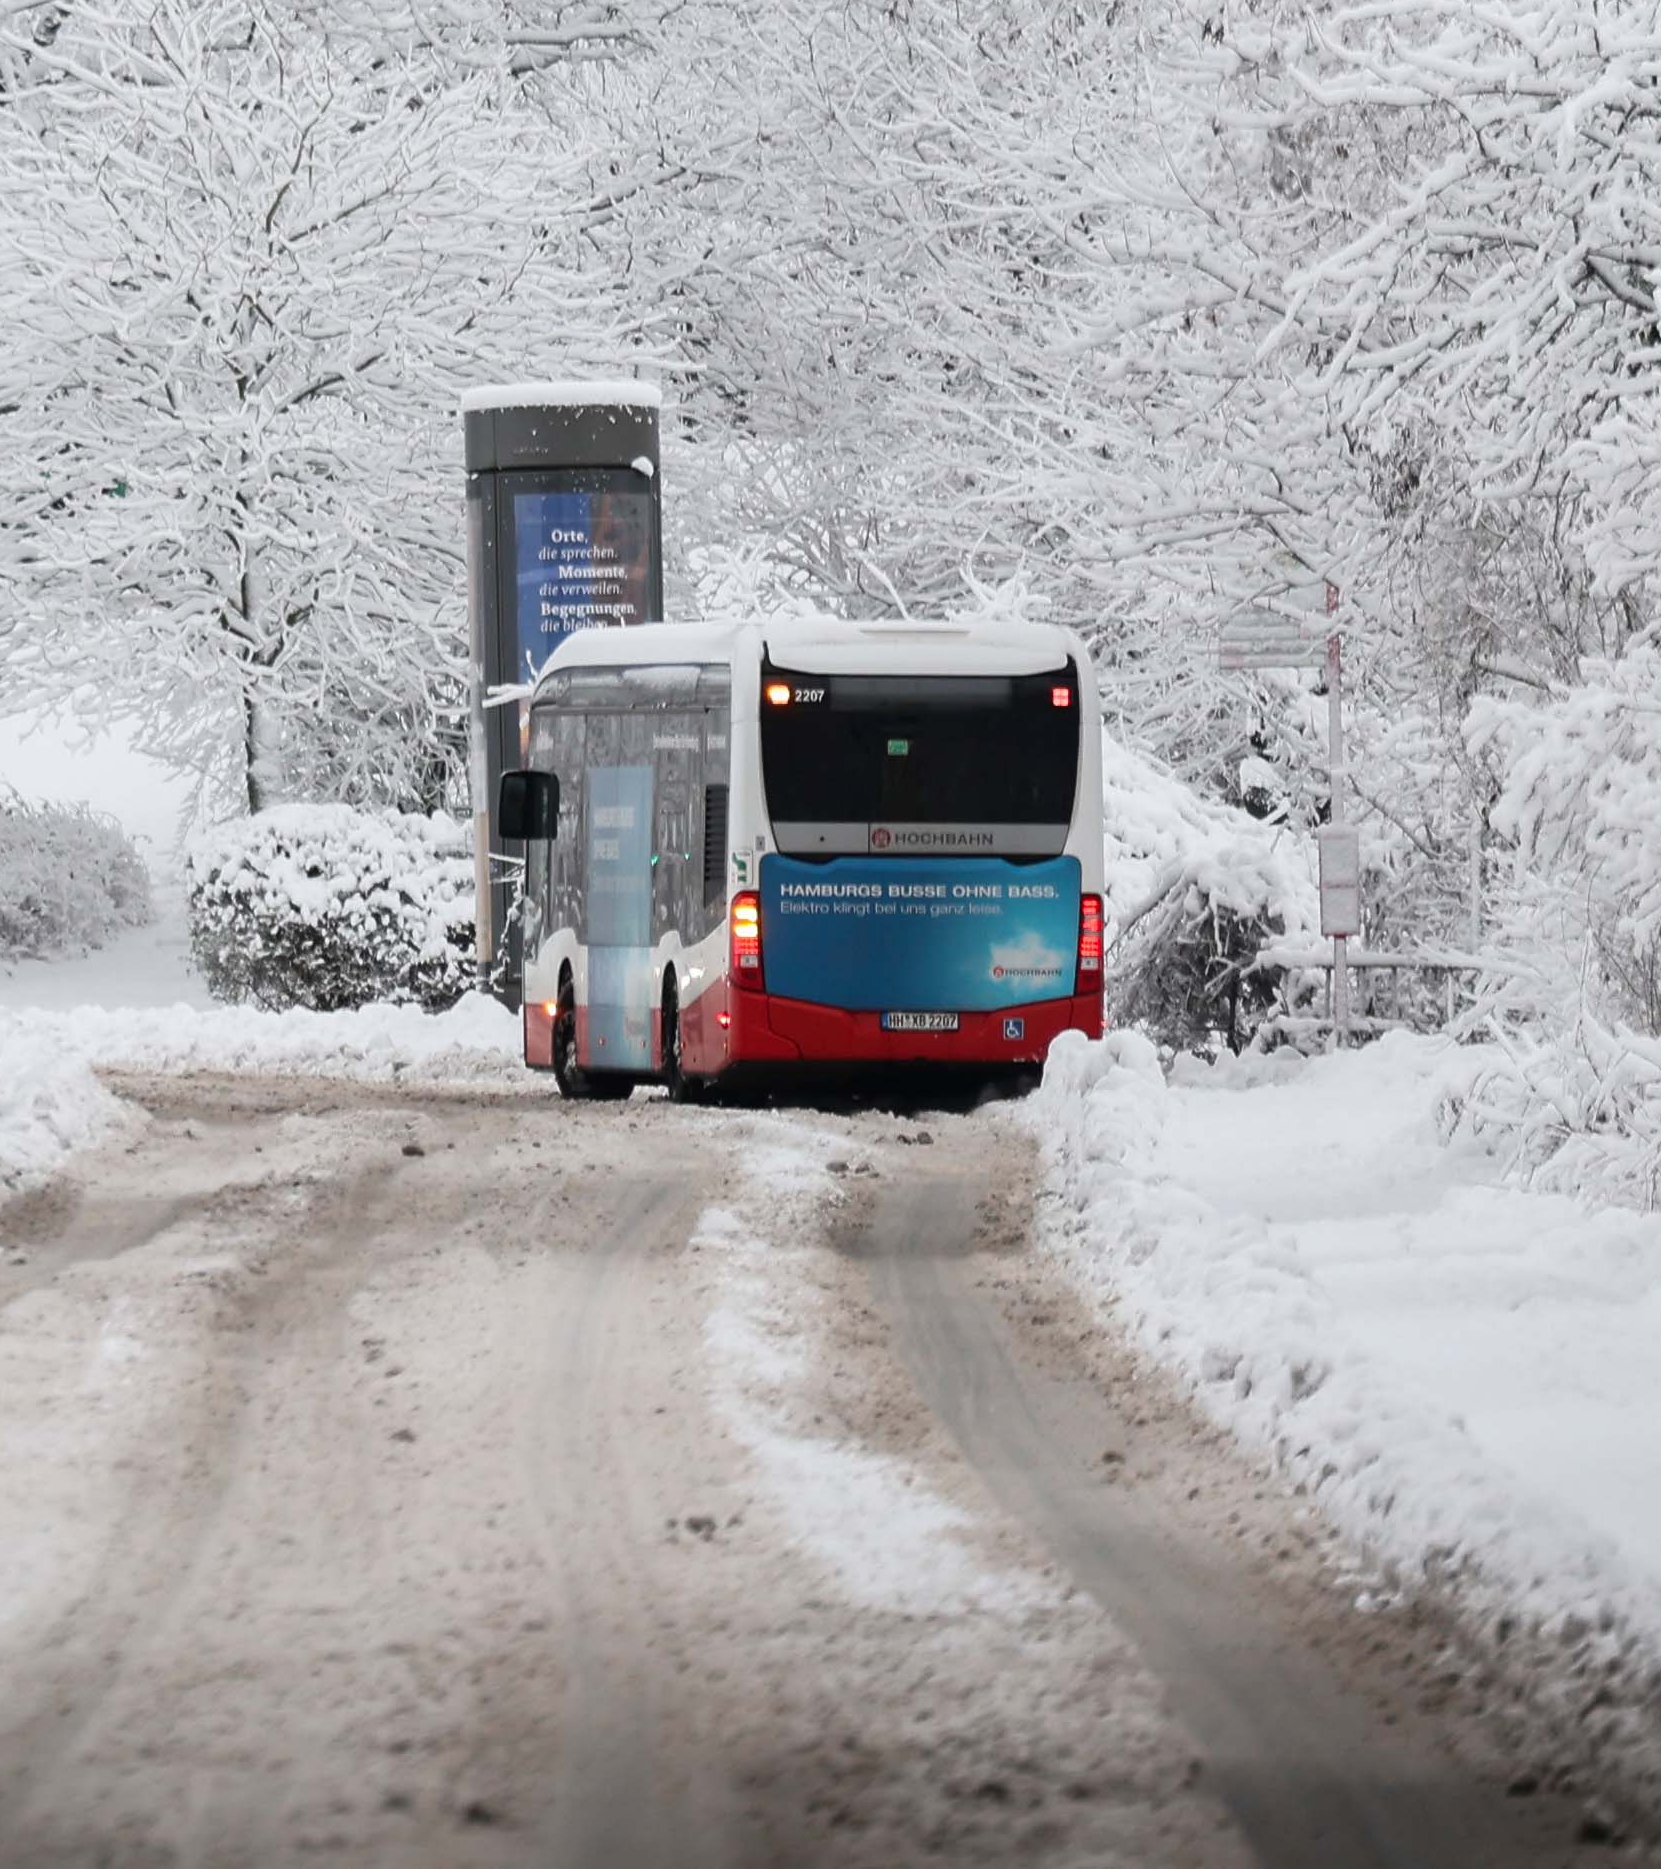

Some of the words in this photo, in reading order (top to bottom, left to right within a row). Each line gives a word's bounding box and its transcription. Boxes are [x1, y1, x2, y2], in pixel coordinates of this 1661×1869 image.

[551, 529, 589, 544] Orte,
[538, 546, 557, 560] die
[561, 546, 618, 562] sprechen.
[558, 565, 628, 580] Momente,
[539, 582, 558, 596] die
[562, 582, 623, 596] verweilen.
[540, 602, 637, 618] Begegnungen,
[540, 618, 559, 633] die
[795, 689, 825, 703] 2207
[895, 833, 993, 846] HOCHBAHN
[780, 884, 882, 898] HAMBURGS
[888, 884, 946, 898] BUSSE
[952, 885, 1002, 898] OHNE
[1008, 885, 1060, 899] BASS.
[780, 901, 829, 914] Elektro
[833, 901, 870, 917] klingt
[875, 901, 896, 914] bei
[900, 904, 926, 914] uns
[930, 904, 964, 917] ganz
[1005, 969, 1062, 977] HOCHBAHN
[889, 1014, 904, 1027] HH
[929, 1014, 957, 1027] 2207
